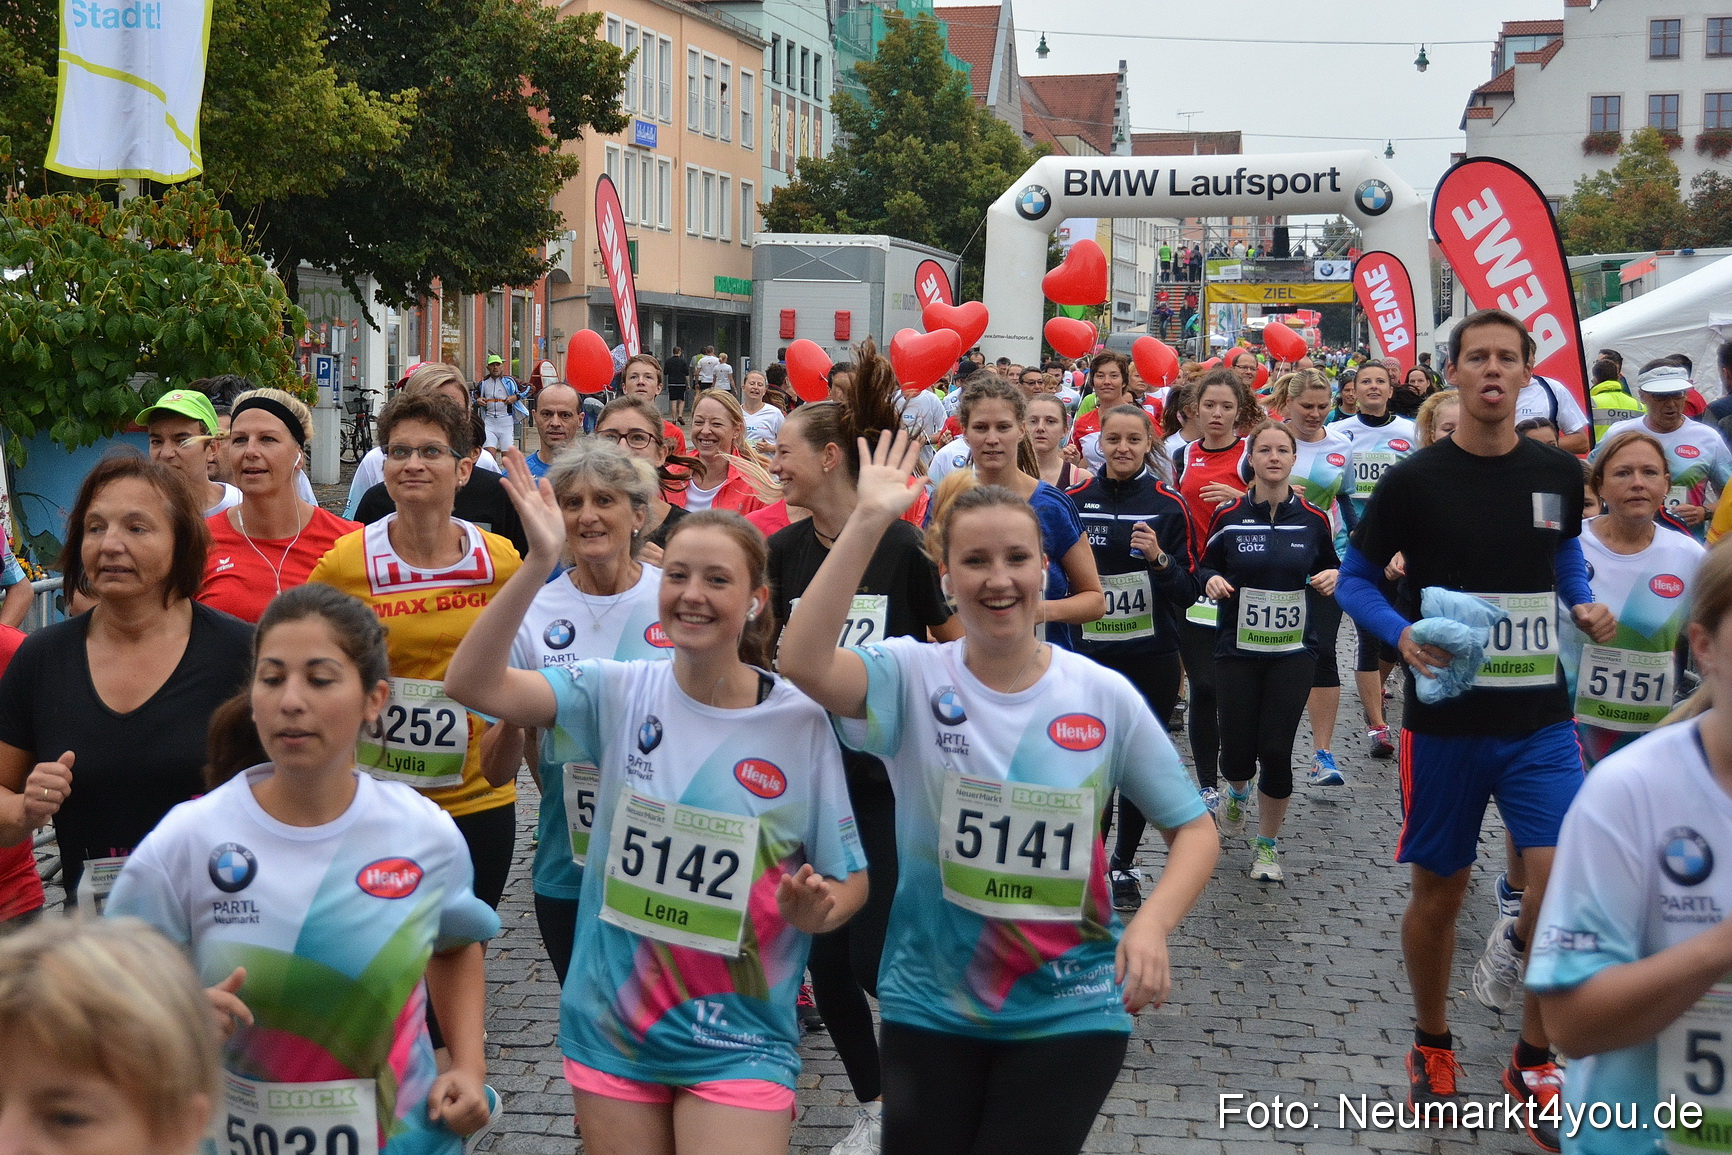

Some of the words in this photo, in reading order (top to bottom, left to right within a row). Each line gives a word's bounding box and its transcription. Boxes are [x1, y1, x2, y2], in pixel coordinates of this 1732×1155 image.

[71, 0, 161, 30] Stadt!
[1064, 169, 1160, 197] BMW
[1169, 167, 1342, 200] Laufsport
[1264, 287, 1297, 300] ZIEL
[319, 361, 329, 375] P
[1087, 526, 1108, 534] LAS
[1089, 536, 1107, 546] ötz
[1238, 542, 1265, 553] Götz
[1110, 574, 1143, 585] BOCK
[1654, 579, 1681, 593] Hervis
[1103, 589, 1148, 615] 044
[1270, 593, 1300, 602] BOCK
[1508, 596, 1548, 608] BOCK
[372, 597, 429, 619] MAX
[1246, 604, 1300, 630] 5153
[1096, 621, 1137, 632] Christina
[1493, 616, 1549, 651] 010
[1247, 633, 1294, 643] Annemarie
[544, 653, 579, 664] PARTL
[1484, 661, 1535, 674] Andreas
[1628, 653, 1668, 666] BOCK
[404, 682, 448, 699] BOC
[1589, 665, 1666, 702] 5151
[1597, 704, 1650, 722] Susanne
[1056, 722, 1101, 743] Hervis
[387, 752, 427, 773] Lydia
[742, 762, 782, 792] Hervis
[956, 788, 1002, 804] NeuerMarkt
[1012, 788, 1083, 810] BOCK
[626, 806, 666, 825] NeuerMarkt
[674, 809, 745, 839] BOCK
[955, 808, 1075, 871] 5141
[621, 826, 740, 901] 5142
[366, 869, 419, 890] Hervis
[985, 878, 1033, 899] Anna
[213, 901, 260, 914] PARTL
[644, 896, 690, 926] Lena
[214, 915, 260, 925] Neumarkt
[695, 999, 729, 1027] 17.
[268, 1087, 359, 1110] BOCK
